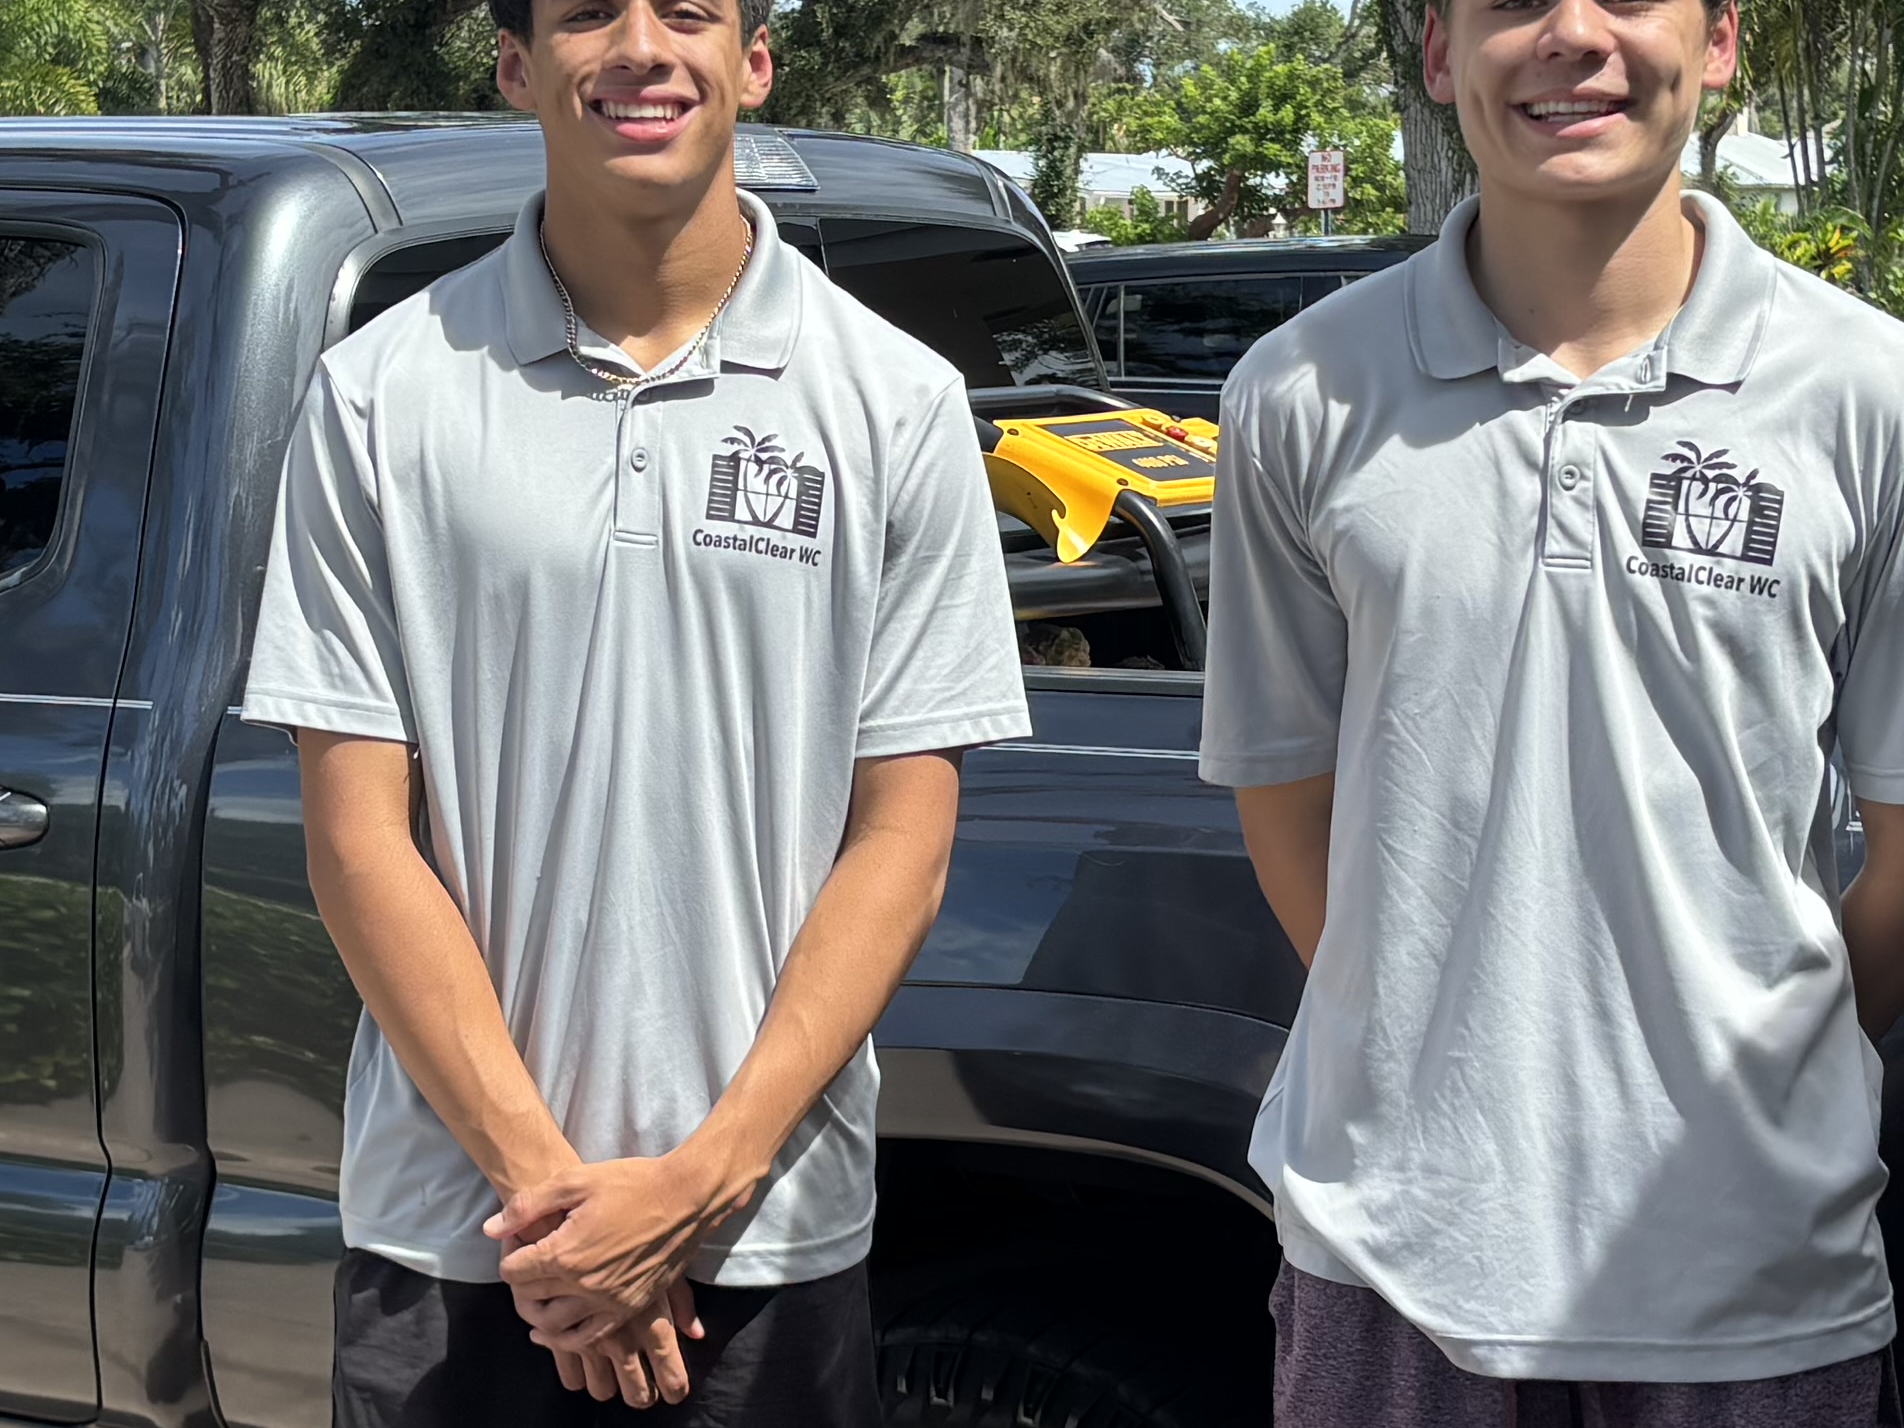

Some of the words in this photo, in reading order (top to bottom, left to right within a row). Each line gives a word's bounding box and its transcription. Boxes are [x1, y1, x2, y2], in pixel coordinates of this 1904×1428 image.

[692, 528, 796, 562] CoastalClear
[797, 545, 822, 567] WC
[1626, 555, 1745, 592] CoastalClear
[1749, 575, 1781, 599] WC
